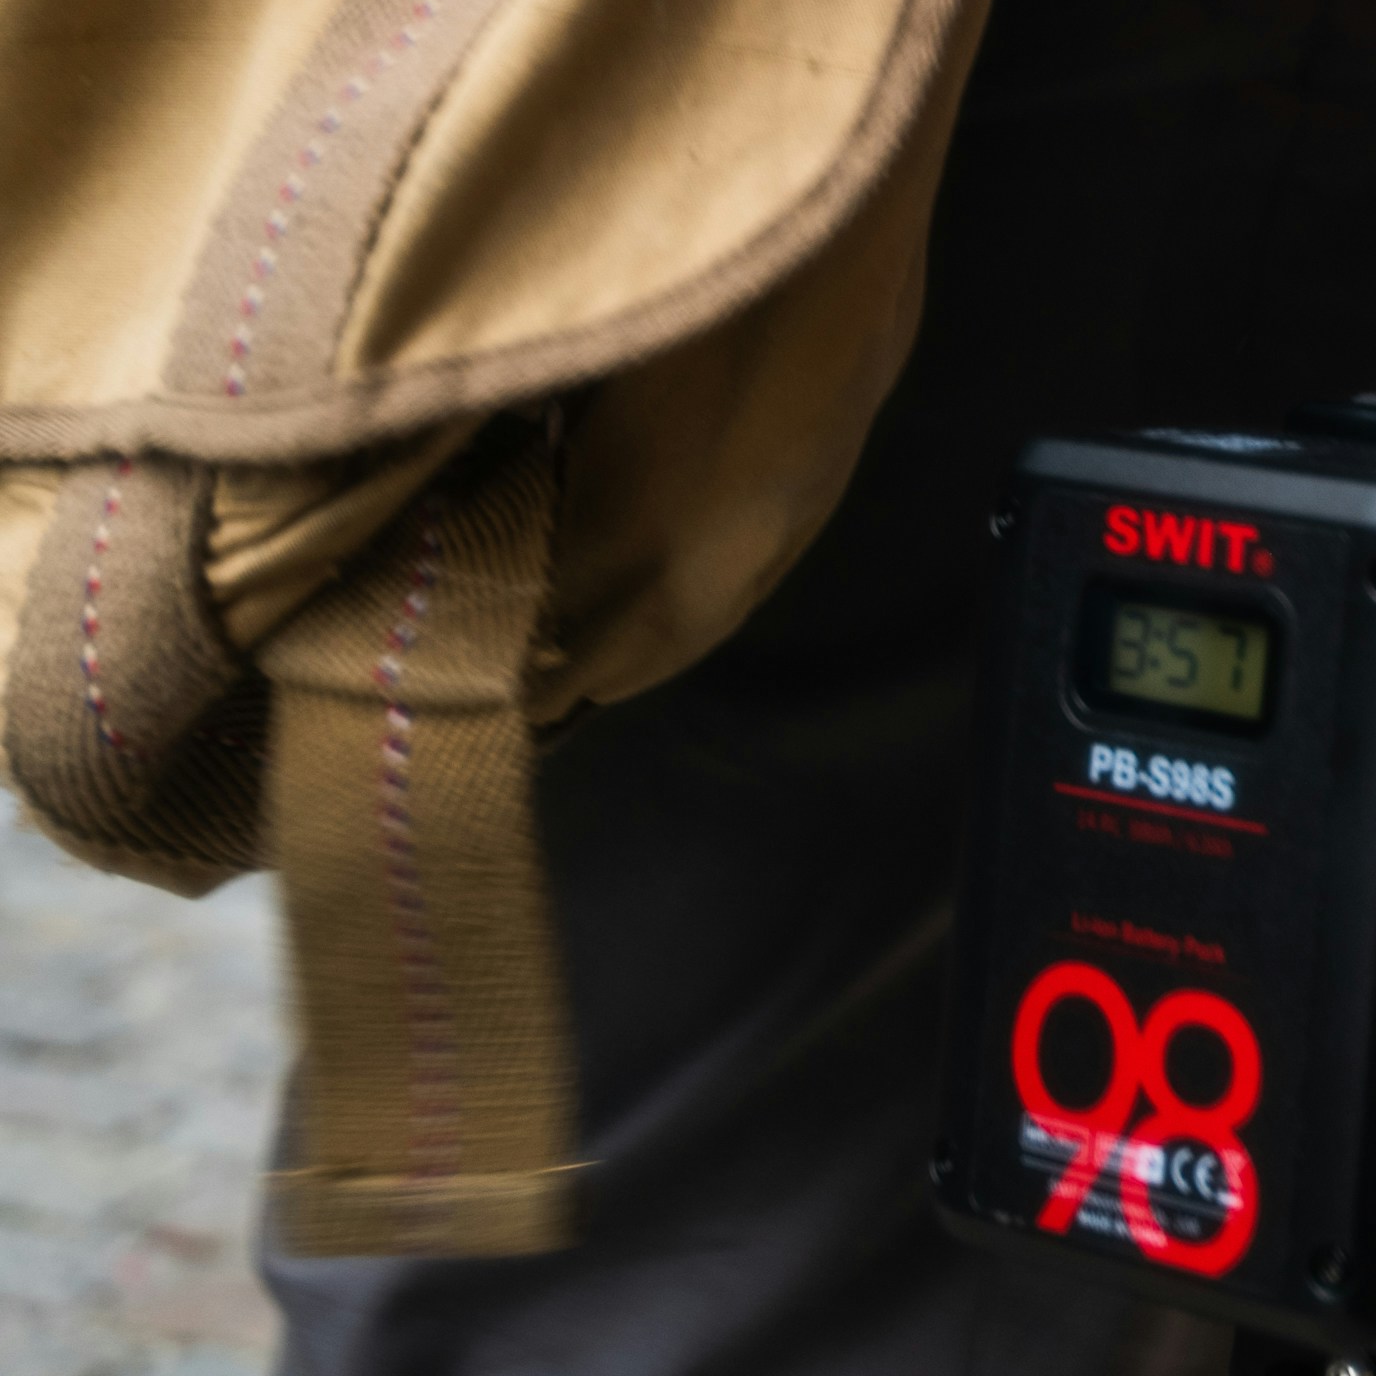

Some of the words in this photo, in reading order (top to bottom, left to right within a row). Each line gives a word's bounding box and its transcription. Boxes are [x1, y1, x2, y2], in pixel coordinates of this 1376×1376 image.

[1114, 609, 1248, 692] 3:57
[1089, 743, 1235, 809] PB-S98S
[1011, 959, 1262, 1278] 98
